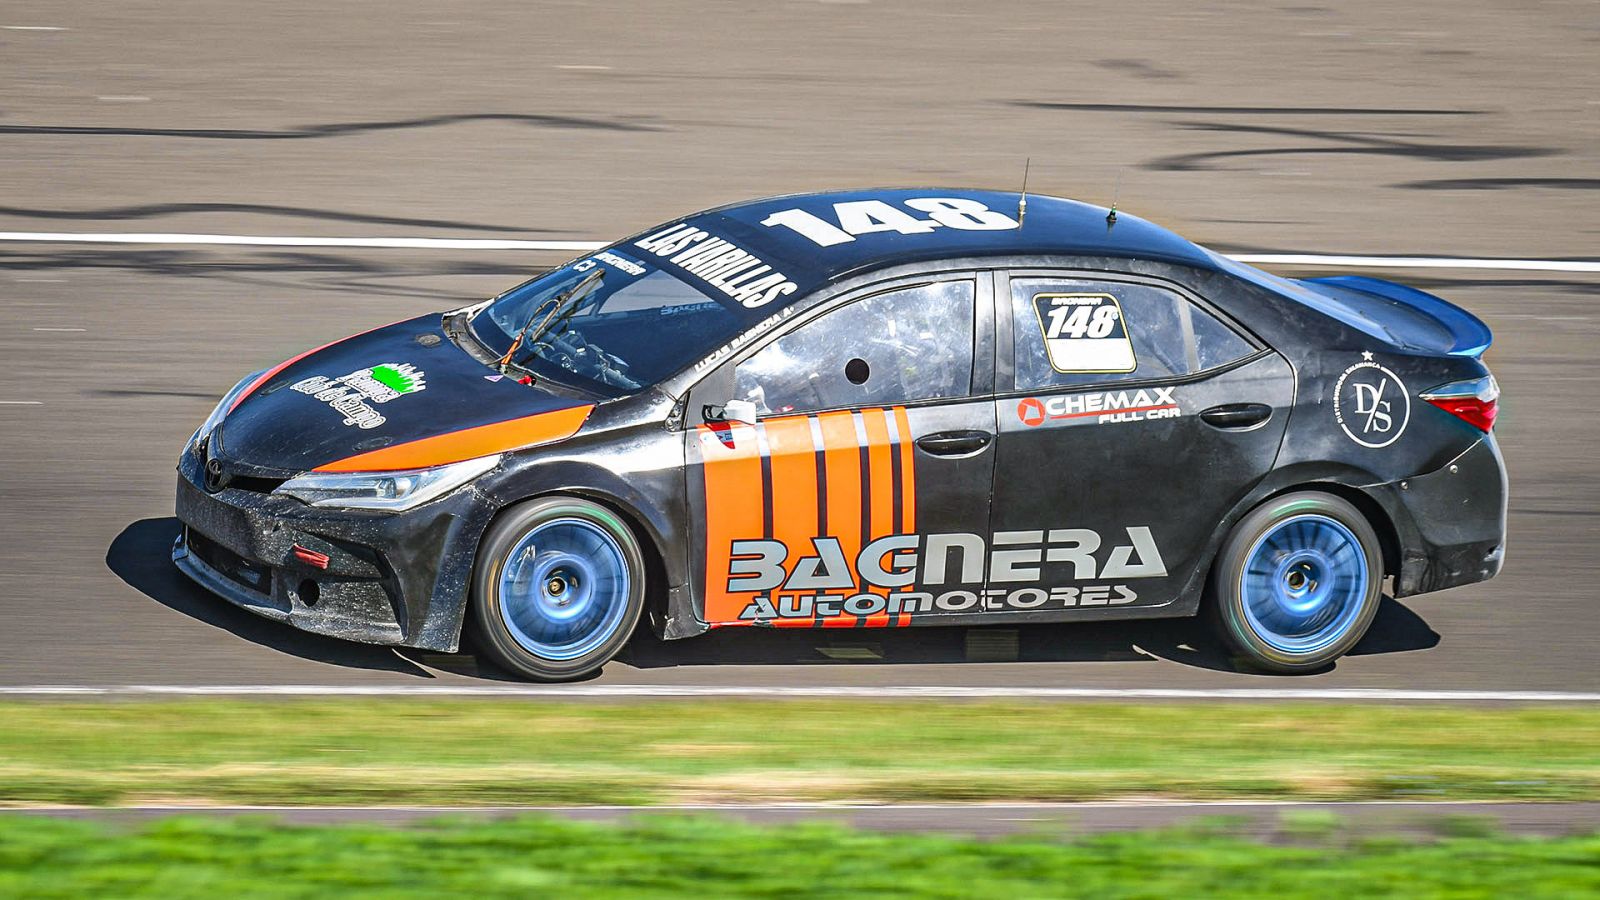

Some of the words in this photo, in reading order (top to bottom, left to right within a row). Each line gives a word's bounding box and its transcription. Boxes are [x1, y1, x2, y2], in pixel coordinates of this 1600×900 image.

[760, 198, 1020, 247] 148
[634, 223, 710, 257] LAS
[669, 236, 798, 309] VARILLAS
[1046, 305, 1118, 339] 148
[694, 344, 731, 373] LUCAS
[314, 385, 352, 402] de
[1045, 386, 1177, 416] CHEMAX
[329, 393, 387, 429] Campo
[1098, 411, 1144, 425] FULL
[1146, 408, 1182, 420] CAR
[727, 526, 1168, 592] BAGNERA
[738, 585, 1138, 620] AUTOMOTORES
